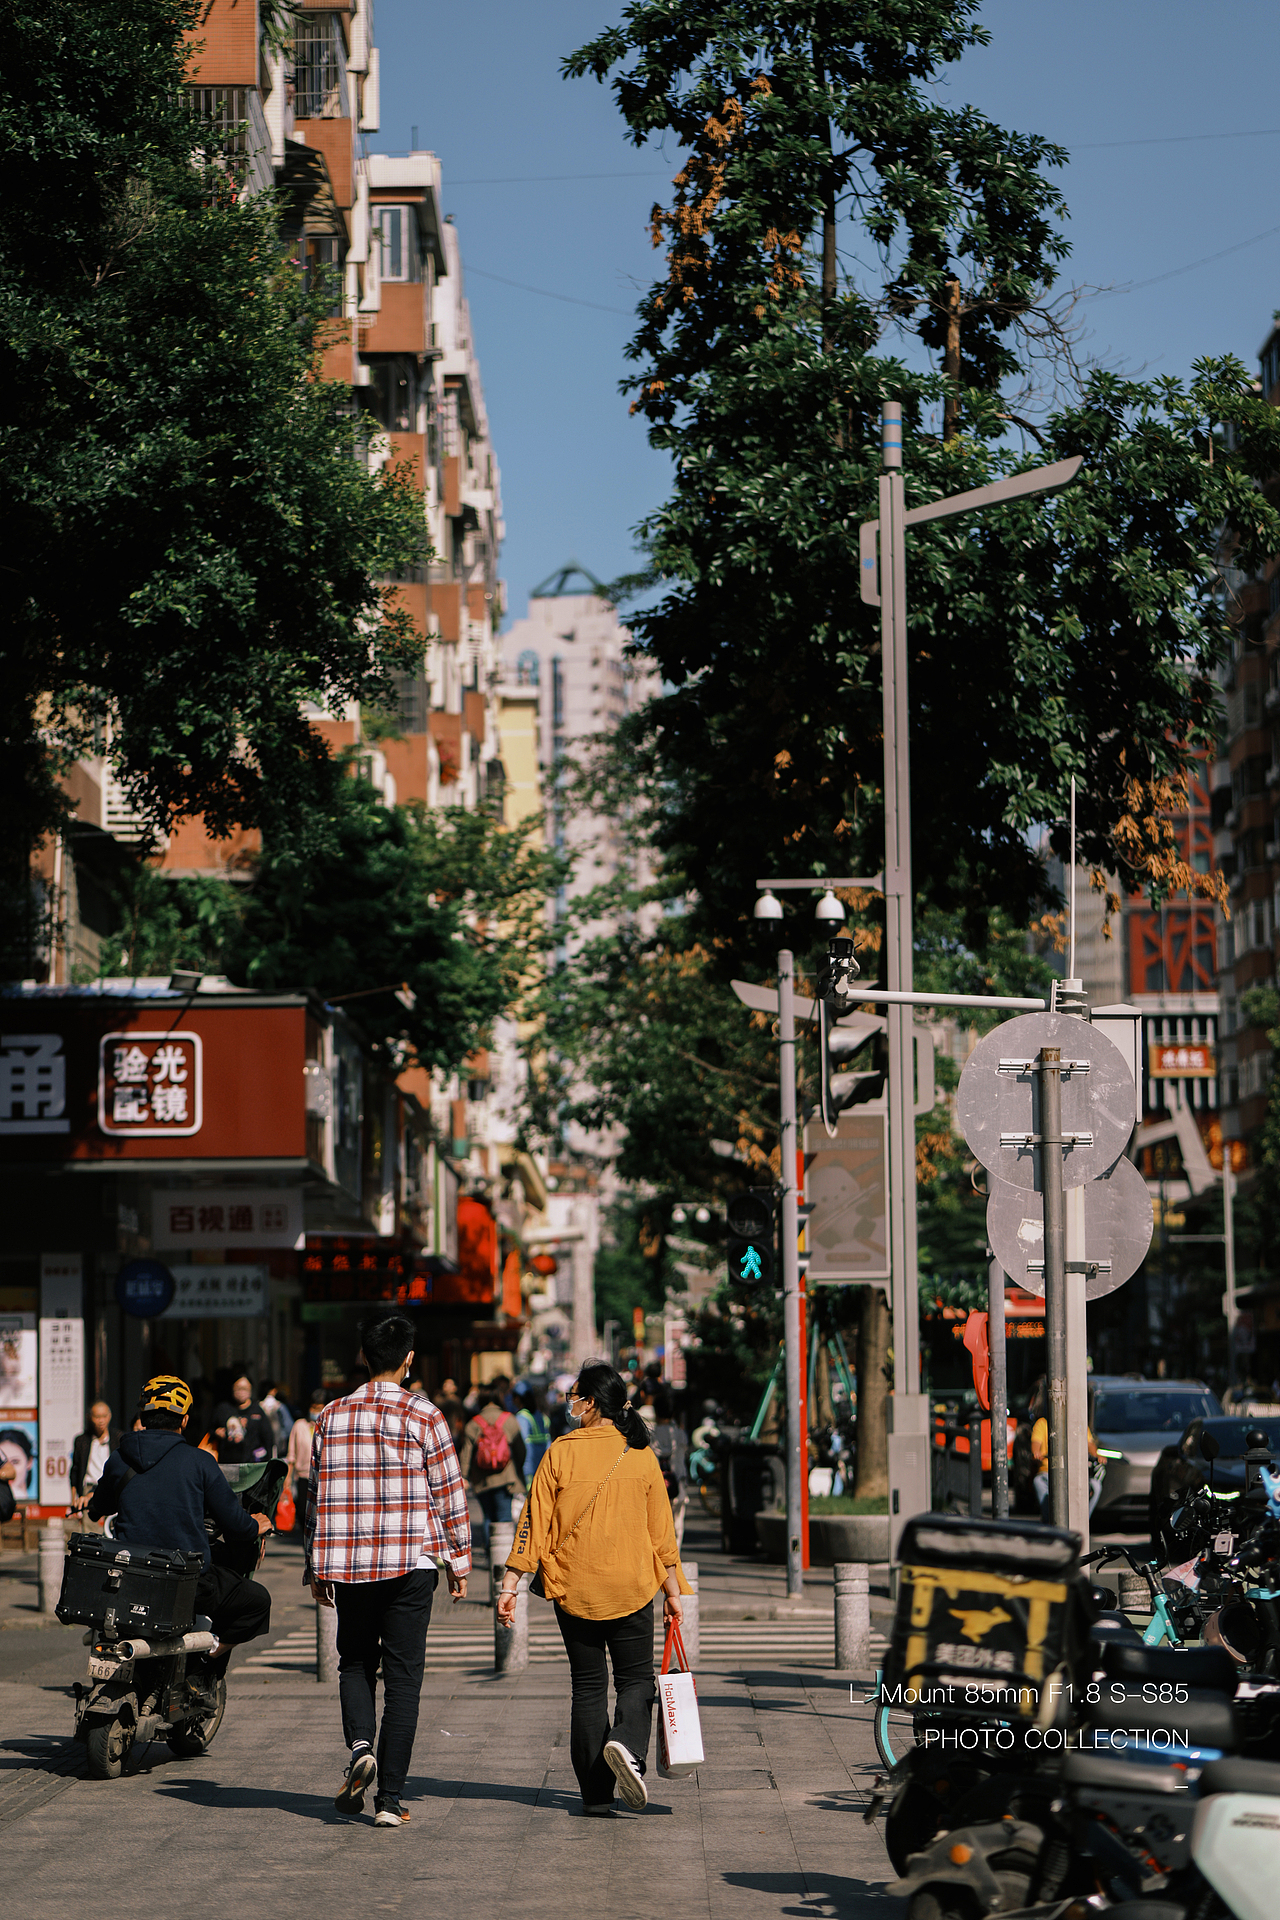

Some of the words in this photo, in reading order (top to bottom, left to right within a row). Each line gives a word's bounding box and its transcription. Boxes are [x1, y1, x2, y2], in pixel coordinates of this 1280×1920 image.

[113, 1045, 188, 1083] 验光
[113, 1084, 188, 1123] 配镜
[169, 1204, 254, 1232] 百视通
[46, 1456, 67, 1477] 60
